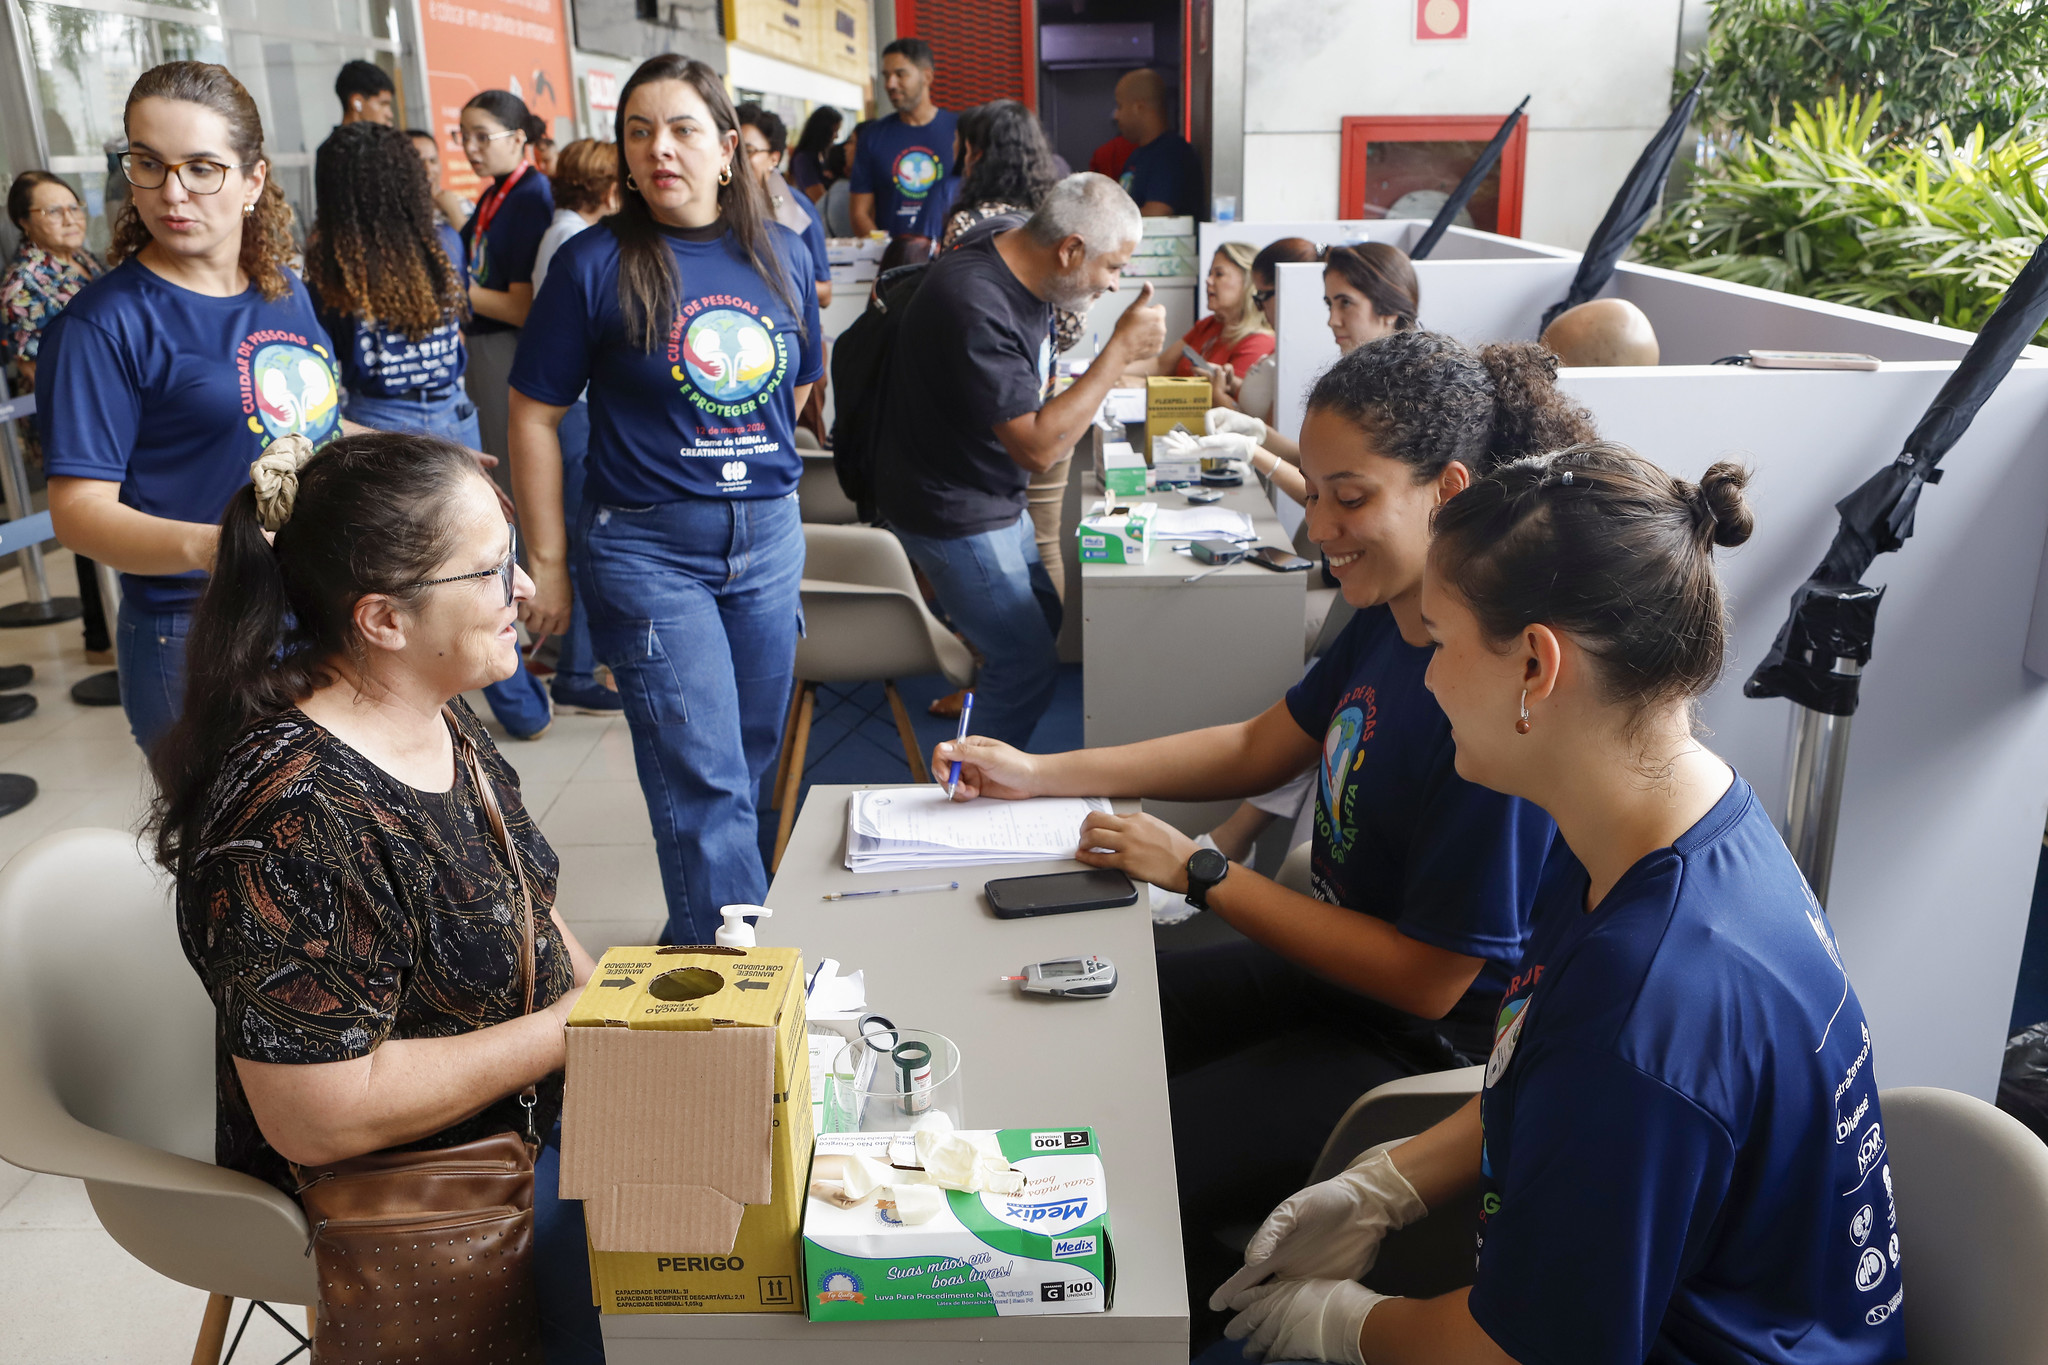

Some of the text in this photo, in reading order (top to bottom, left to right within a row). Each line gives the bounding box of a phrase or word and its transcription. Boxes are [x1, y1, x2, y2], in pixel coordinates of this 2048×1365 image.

[667, 294, 759, 362] CUIDAR DE PESSOAS
[236, 329, 308, 414] CUIDAR DE PESSOAS
[680, 332, 788, 417] E PROTEGER O PLANETA
[695, 425, 706, 434] 12
[708, 426, 719, 435] de
[695, 437, 722, 447] Exame
[723, 437, 734, 446] de
[735, 435, 761, 445] URINA
[680, 442, 779, 457] CREATININA para TODOS
[1835, 1045, 1868, 1109] straZeneca
[1035, 1139, 1062, 1147] 100
[1070, 1134, 1082, 1142] G
[1028, 1175, 1056, 1187] boas
[1063, 1177, 1095, 1188] Suas
[1006, 1202, 1088, 1224] Medix
[1055, 1239, 1093, 1253] Medix
[657, 1257, 744, 1272] PERIGO
[886, 1252, 992, 1280] Suas mãos em
[931, 1260, 1014, 1289] boas luvas!
[995, 1289, 1033, 1298] Cirúrgico
[1047, 1289, 1058, 1299] G
[1066, 1282, 1093, 1293] 100
